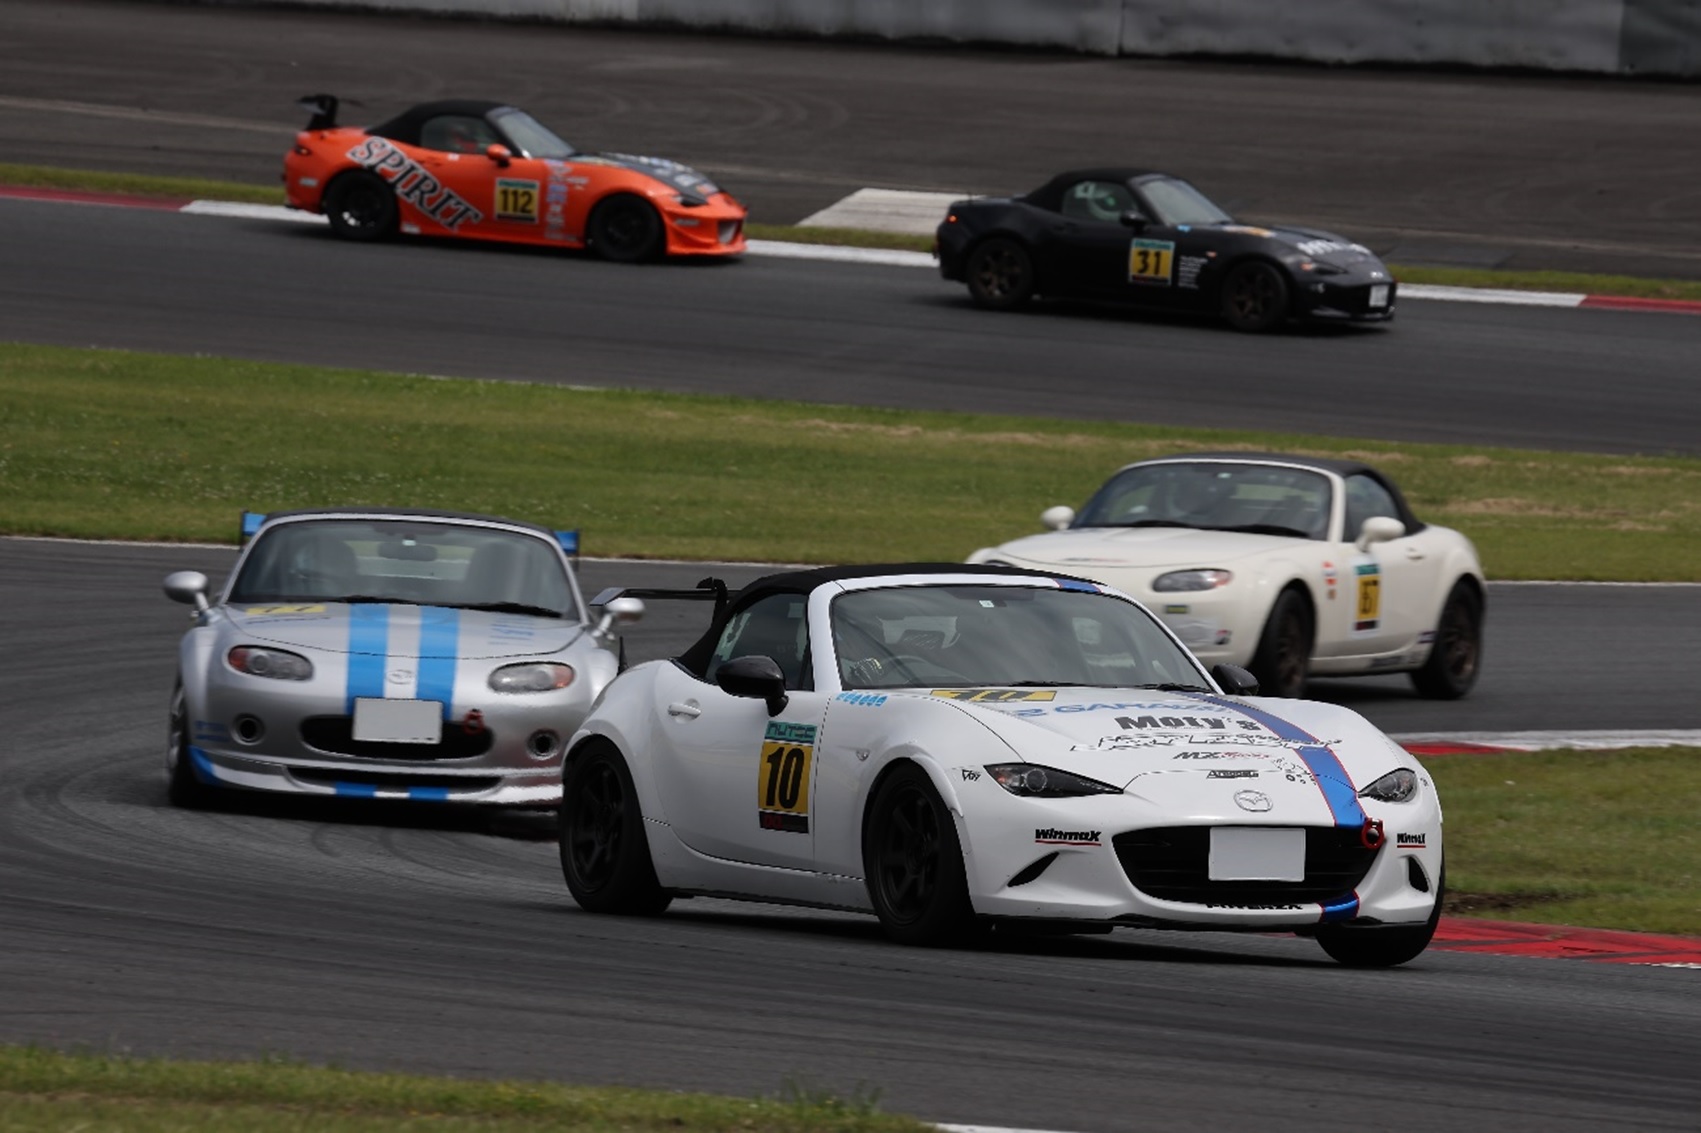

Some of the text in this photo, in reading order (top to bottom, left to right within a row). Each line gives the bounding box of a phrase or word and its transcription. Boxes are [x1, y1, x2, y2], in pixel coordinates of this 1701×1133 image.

[346, 137, 483, 231] SPIRIT
[501, 189, 533, 213] 112
[1137, 250, 1161, 275] 31
[766, 747, 804, 809] 10
